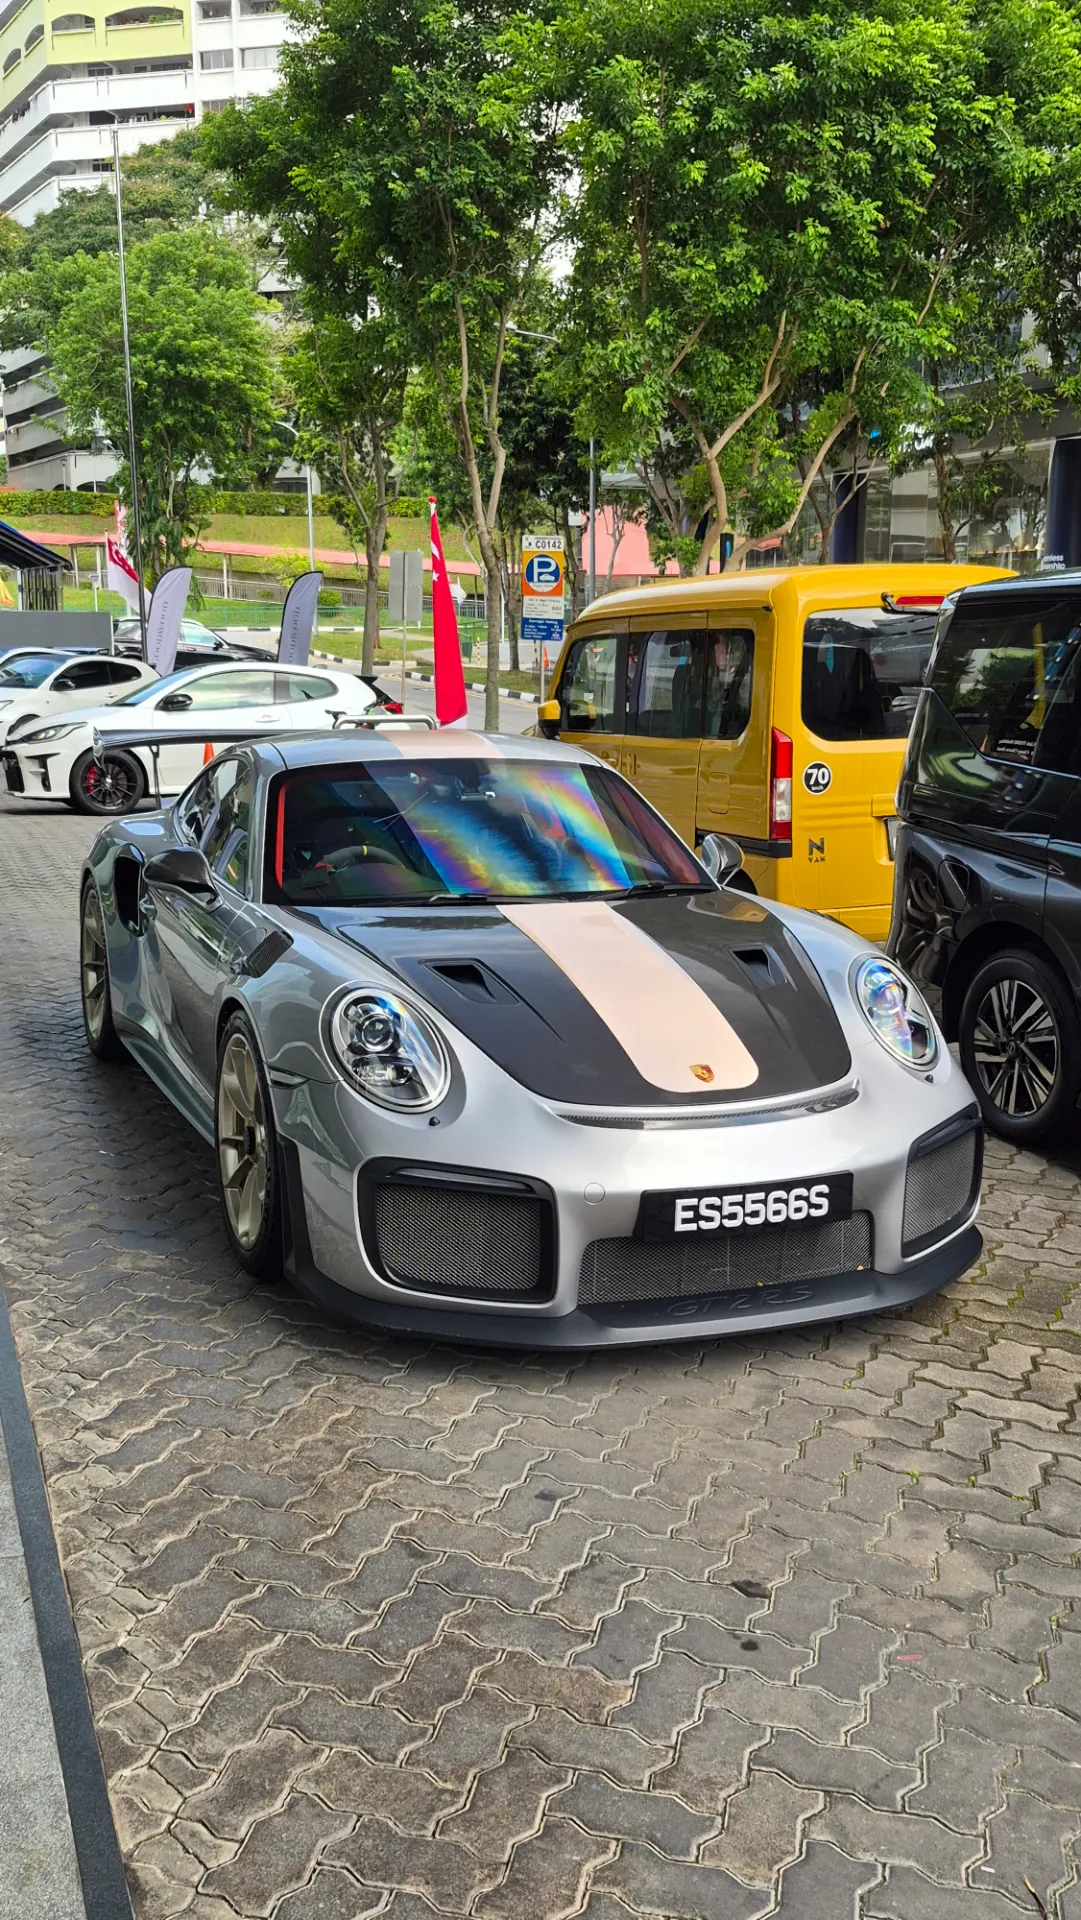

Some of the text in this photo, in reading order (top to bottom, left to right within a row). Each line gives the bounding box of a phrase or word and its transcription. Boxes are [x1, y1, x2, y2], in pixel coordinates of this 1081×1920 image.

[533, 557, 557, 583] P
[288, 606, 301, 663] OODWOOD
[807, 767, 830, 785] 70
[808, 837, 825, 856] N
[808, 856, 826, 864] VAN
[674, 1184, 830, 1232] ES5566S
